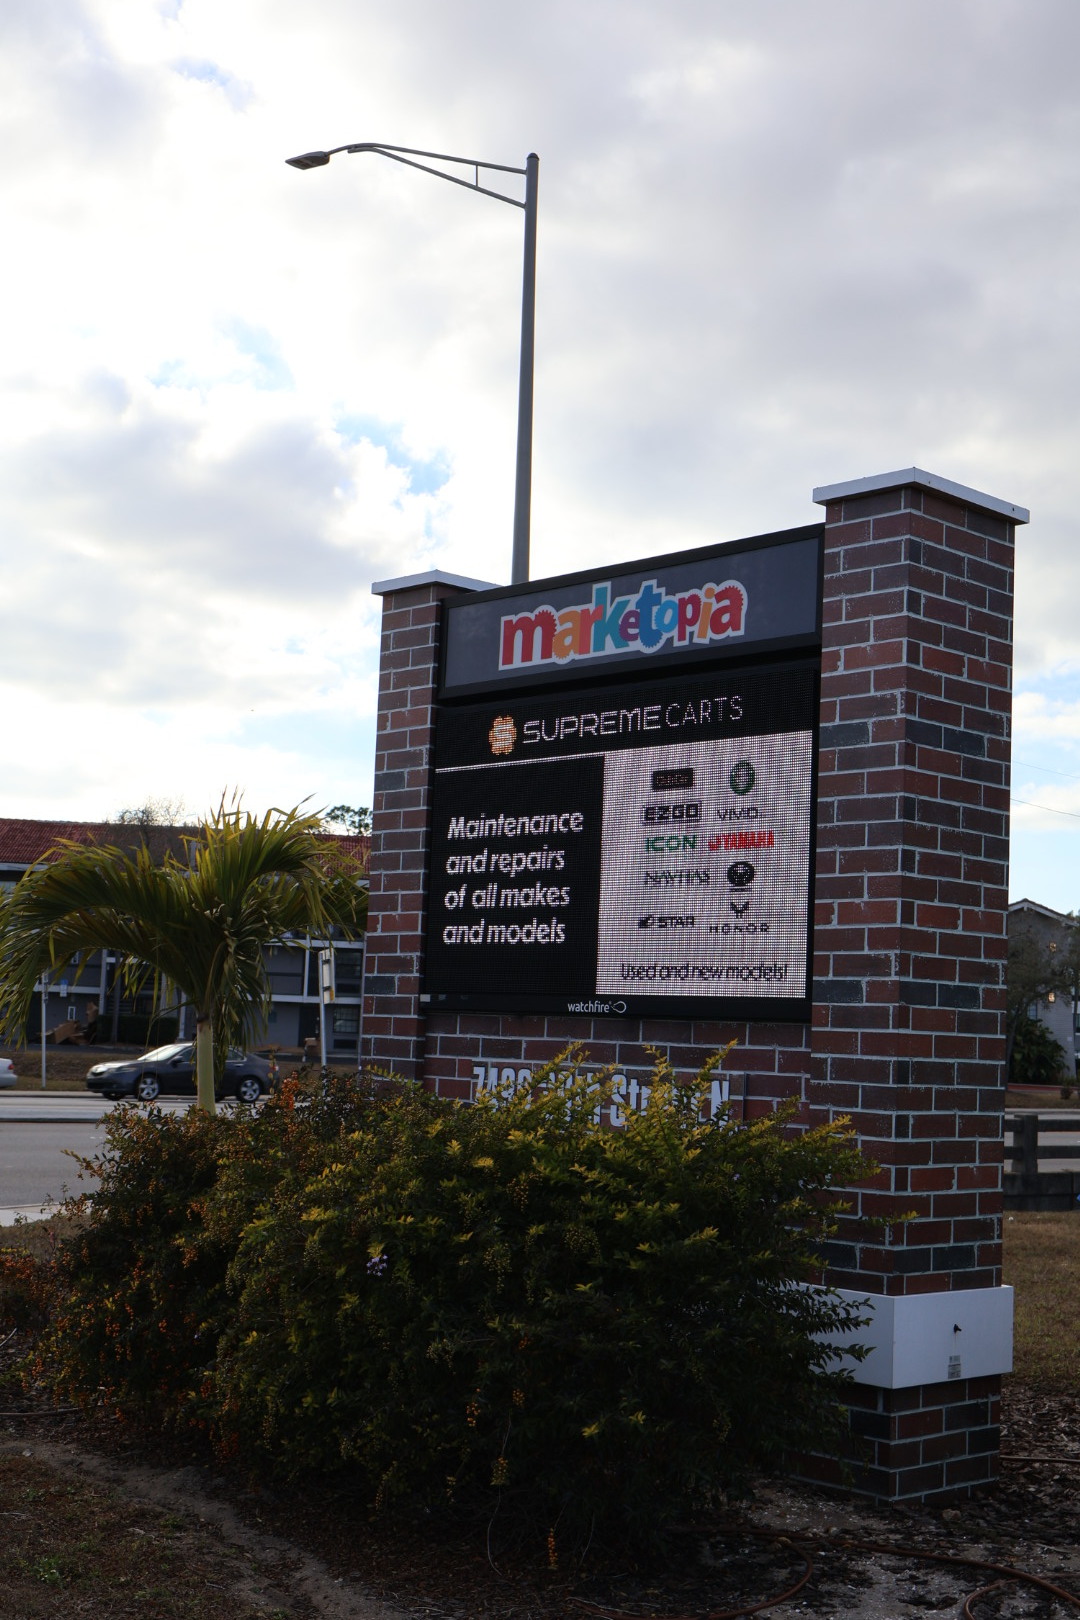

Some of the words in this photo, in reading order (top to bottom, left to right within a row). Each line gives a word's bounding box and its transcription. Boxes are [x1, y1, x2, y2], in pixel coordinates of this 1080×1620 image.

[499, 579, 747, 669] marketopia
[522, 705, 661, 744] SUPREME
[665, 695, 744, 728] CARTS
[447, 812, 584, 840] Maintenance
[646, 834, 697, 851] ICON
[445, 847, 488, 874] and
[490, 844, 565, 877] repairs
[444, 883, 468, 910] of
[472, 882, 498, 909] all
[499, 880, 571, 908] makes
[442, 918, 485, 944] and
[486, 916, 566, 944] models
[658, 915, 695, 928] STAR
[709, 922, 770, 935] HONOR
[621, 963, 657, 980] Used
[659, 963, 689, 980] and
[691, 965, 725, 980] new
